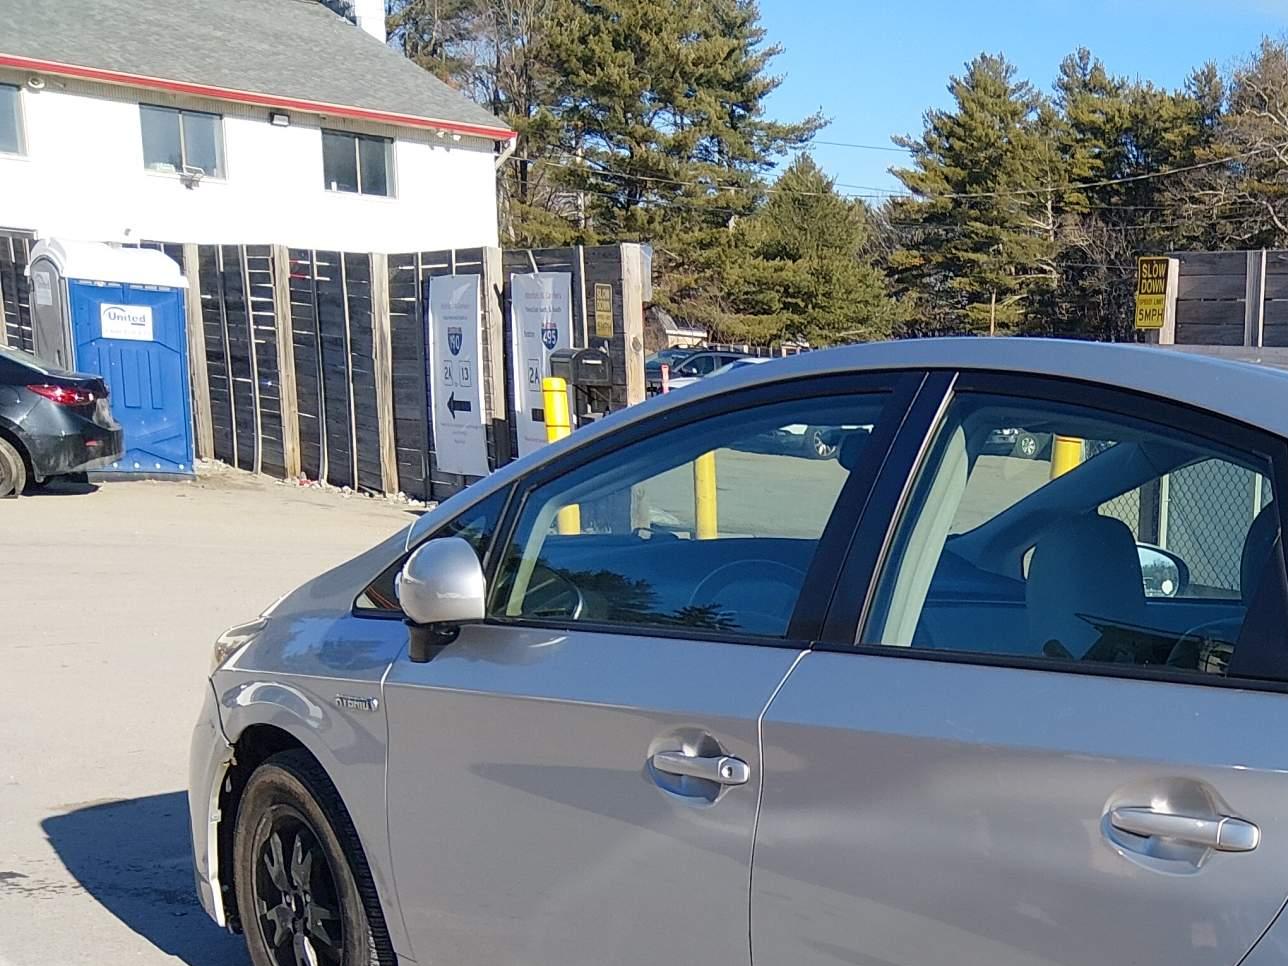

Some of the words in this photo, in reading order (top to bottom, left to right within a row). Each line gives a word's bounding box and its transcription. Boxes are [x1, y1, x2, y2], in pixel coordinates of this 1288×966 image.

[1142, 263, 1166, 278] SLOW
[1141, 279, 1165, 294] DOWN
[108, 311, 146, 323] United
[543, 329, 557, 345] 495
[461, 367, 469, 381] 13
[529, 366, 541, 384] 2A
